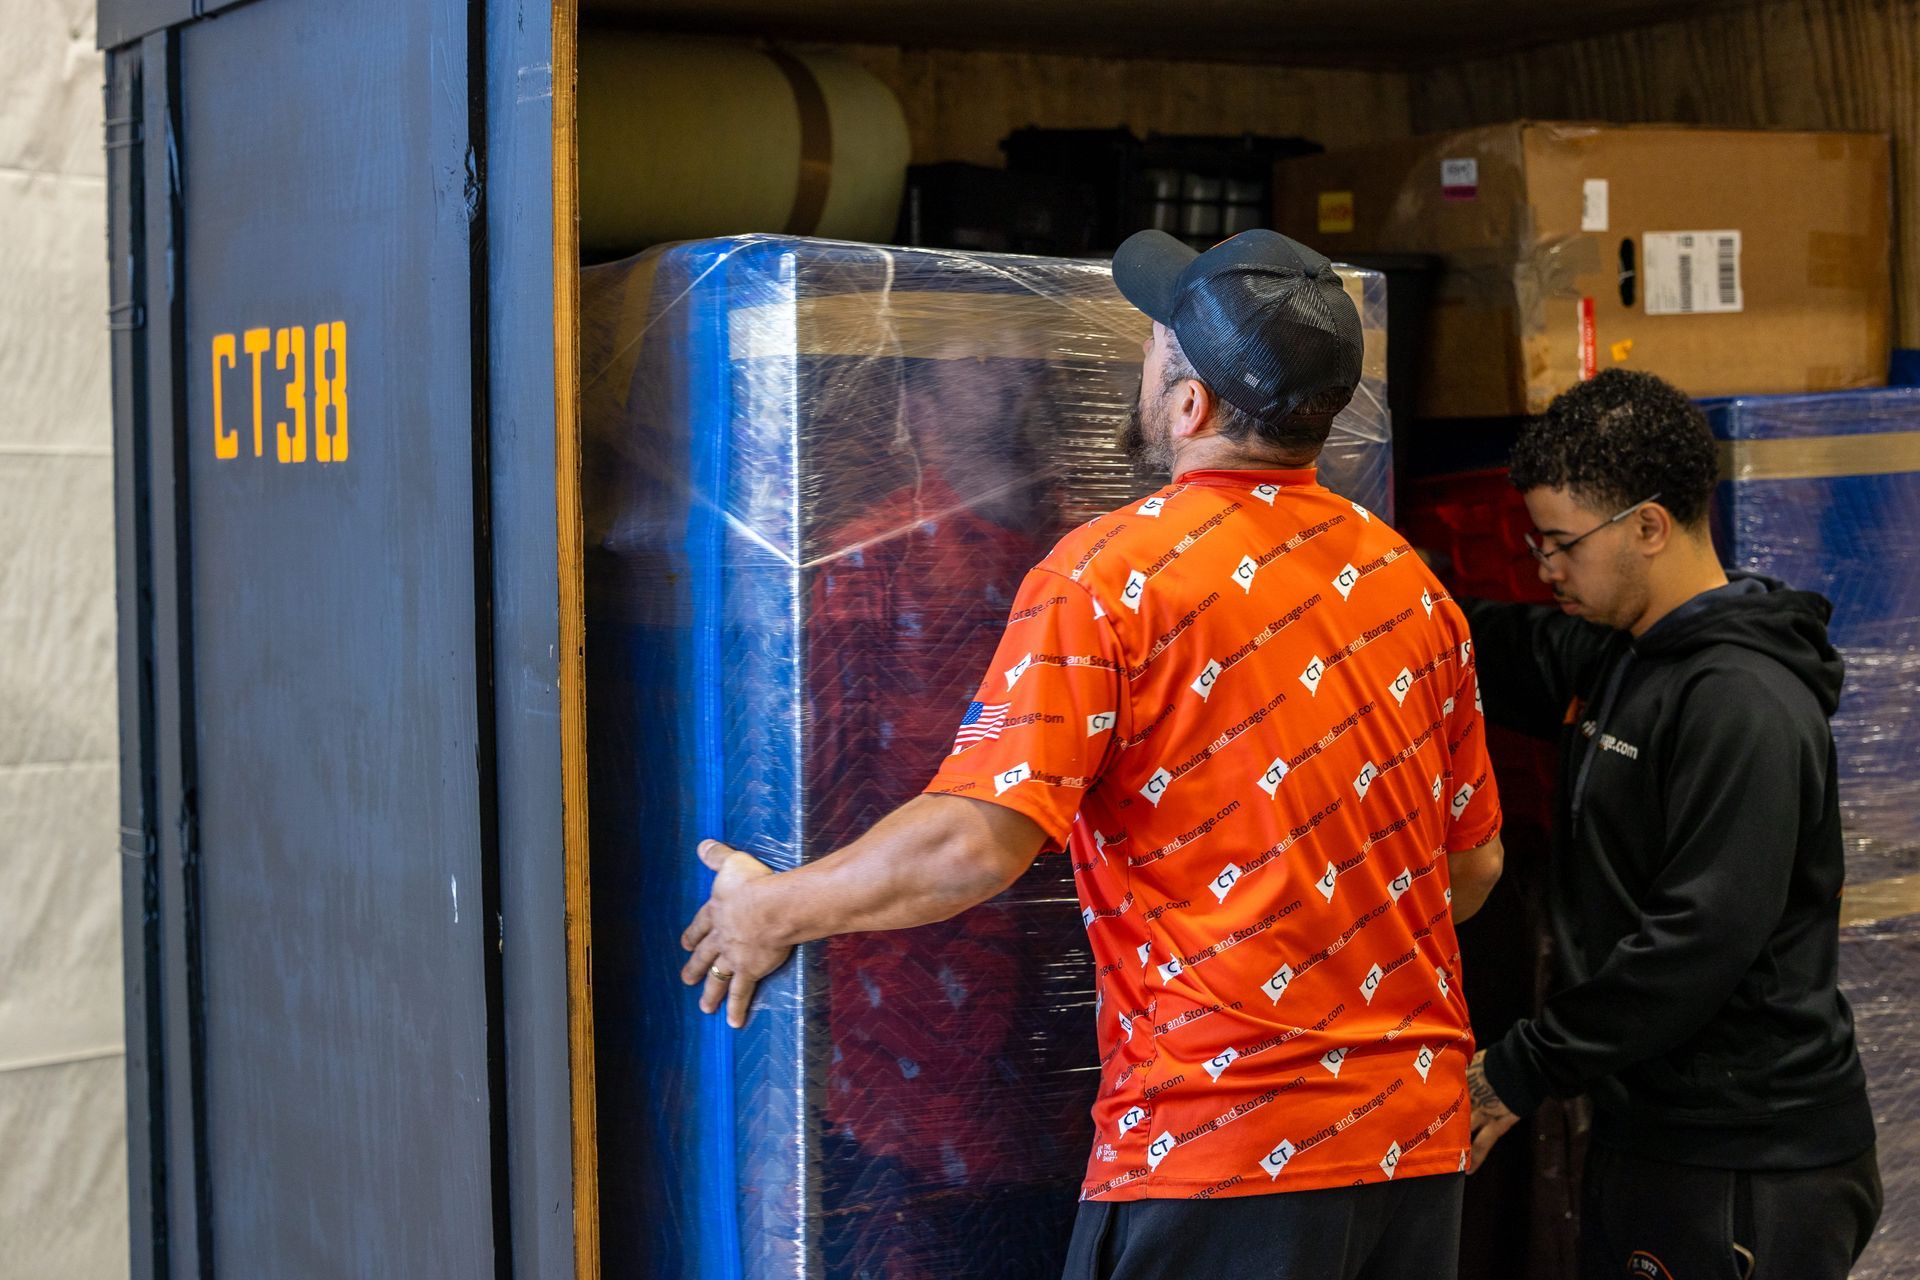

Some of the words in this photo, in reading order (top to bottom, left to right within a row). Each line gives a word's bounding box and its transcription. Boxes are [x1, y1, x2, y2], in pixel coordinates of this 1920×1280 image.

[212, 321, 348, 463] CT38
[1125, 578, 1142, 599] CT
[1143, 501, 1244, 578] MovingandStorage.com
[1238, 563, 1254, 580] CT
[1255, 513, 1346, 568] MovingandStorage.com
[1338, 571, 1355, 588] CT
[1200, 667, 1216, 687] CT
[1221, 592, 1323, 671] MovingandStorage.com
[1306, 663, 1322, 681] CT
[1323, 606, 1415, 669] MovingandStorage.com
[1395, 675, 1411, 692] CT
[1092, 715, 1110, 730] CT
[1147, 775, 1166, 794] CT
[1170, 692, 1288, 779] MovingandStorage.com
[1003, 769, 1022, 784] CT
[1266, 765, 1282, 785] CT
[1359, 768, 1372, 787] CT
[1453, 790, 1469, 808] CT
[1217, 870, 1236, 889] CT
[1392, 875, 1410, 892] CT
[1178, 900, 1303, 967] MovingandStorage.com
[1270, 971, 1288, 991] CT
[1293, 899, 1392, 975] MovingandStorage.com
[1365, 971, 1379, 990] CT
[1211, 1053, 1232, 1068] CT
[1418, 1051, 1432, 1069] CT
[1123, 1110, 1139, 1127] CT
[1150, 1138, 1169, 1157] CT
[1173, 1075, 1307, 1145] MovingandStorage.com
[1268, 1147, 1288, 1166] CT
[1294, 1077, 1404, 1153] MovingandStorage.com
[1385, 1148, 1399, 1168] CT
